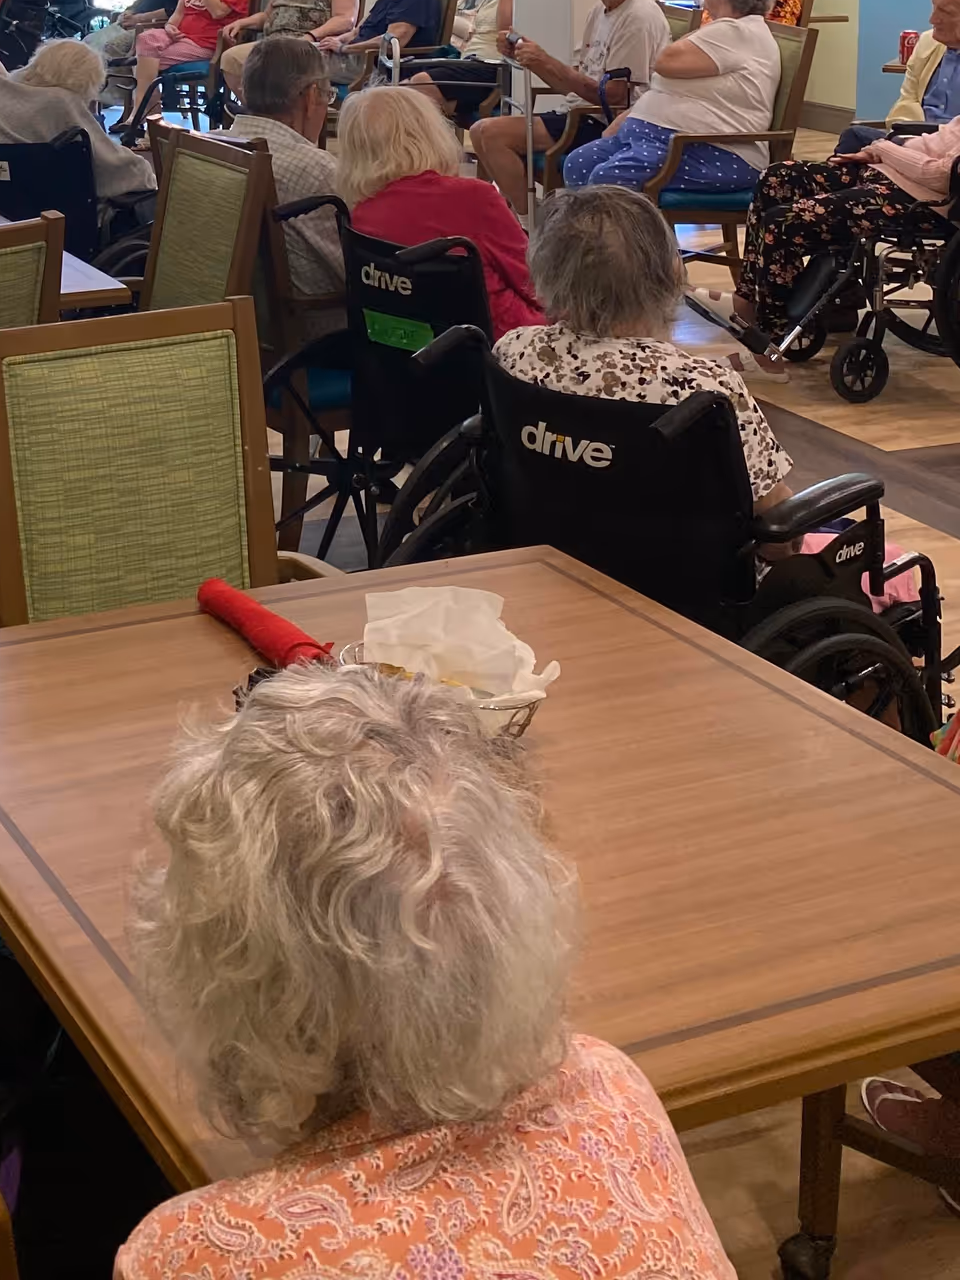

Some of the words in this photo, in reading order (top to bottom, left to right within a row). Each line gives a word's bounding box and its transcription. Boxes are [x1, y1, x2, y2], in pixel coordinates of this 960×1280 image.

[361, 262, 412, 295] drive
[521, 421, 613, 468] drive
[836, 542, 865, 563] drive
